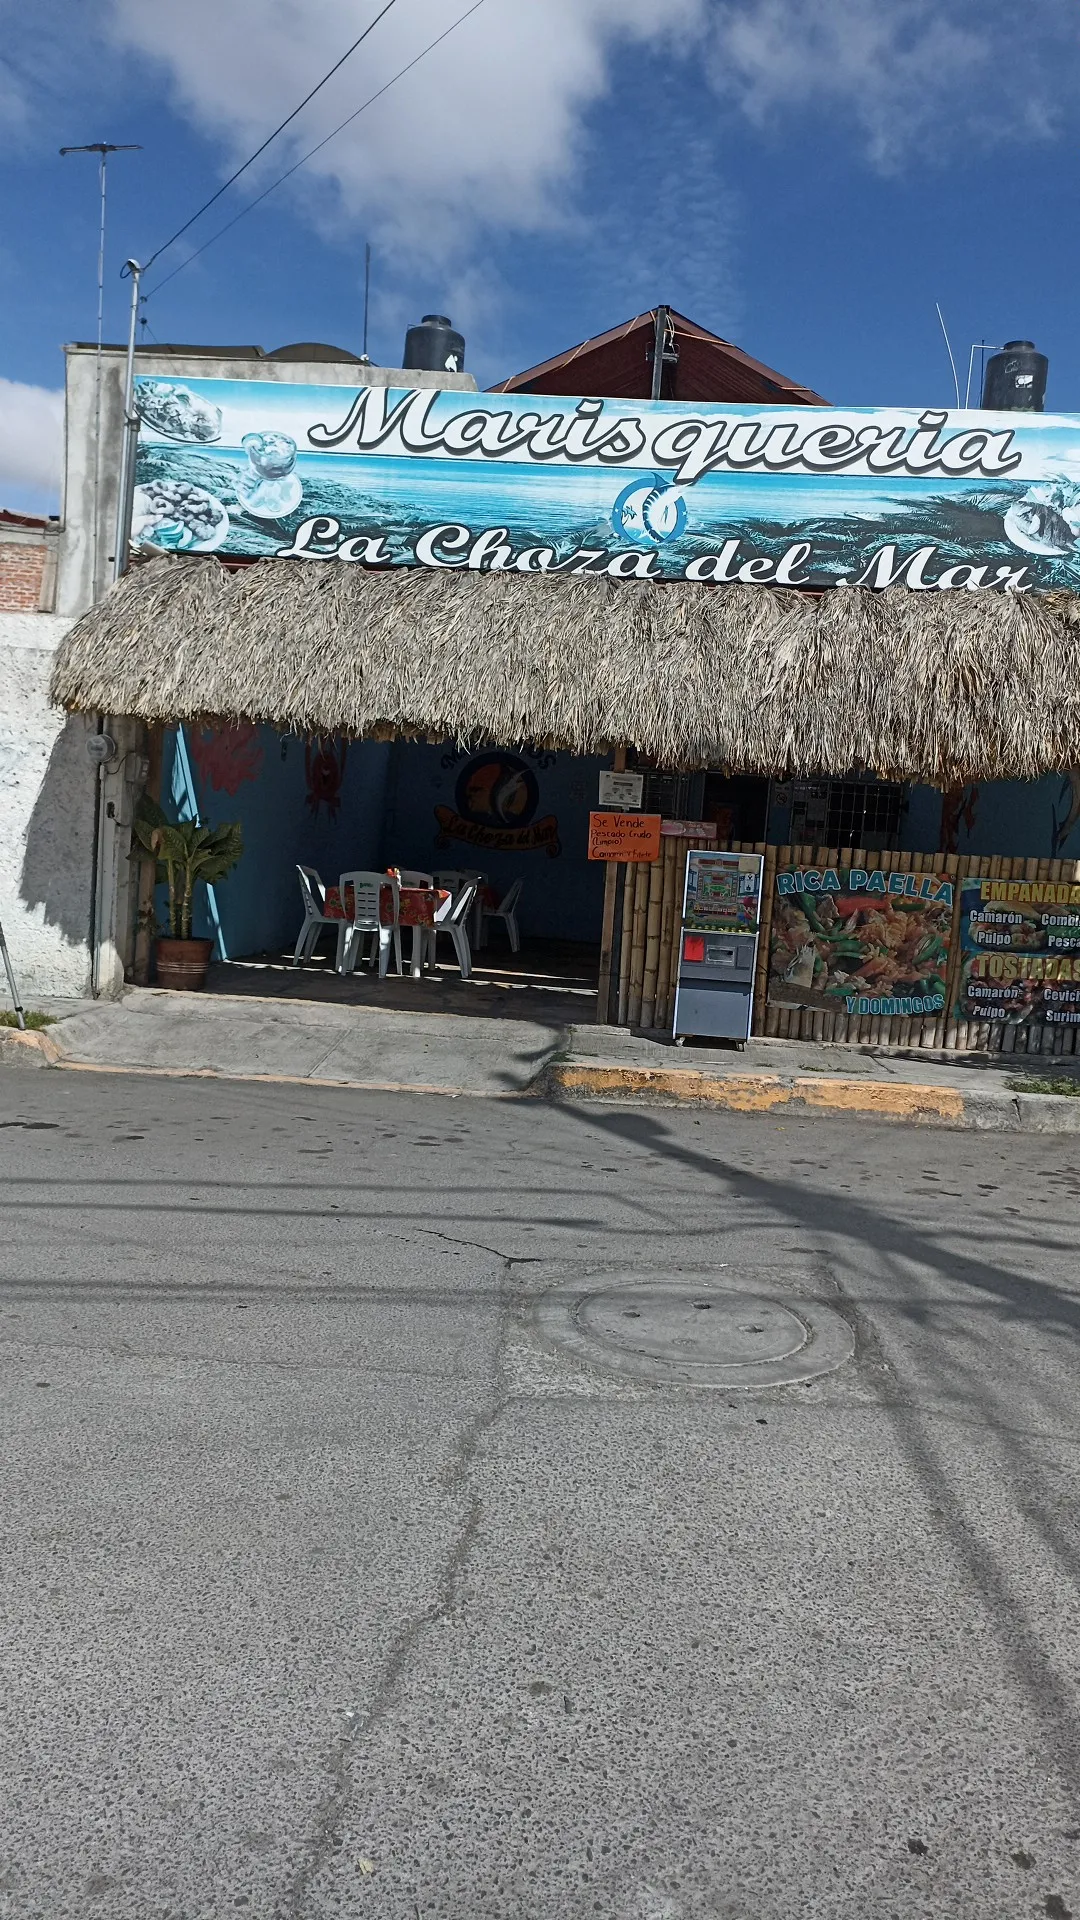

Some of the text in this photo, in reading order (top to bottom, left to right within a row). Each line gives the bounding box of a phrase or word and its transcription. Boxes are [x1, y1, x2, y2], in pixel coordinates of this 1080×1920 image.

[309, 387, 1023, 485] Marisqueria
[276, 516, 1032, 592] La Choza del Mar
[593, 813, 645, 828] Se Vende
[591, 829, 652, 838] Pescado Crudo
[777, 868, 954, 906] RICA PAELLA
[969, 910, 1023, 924] Camarón
[977, 932, 1012, 945] Pulpo
[967, 985, 1018, 998] Camarón
[846, 994, 944, 1015] Y DOMINGOS
[972, 1005, 1006, 1018] Pulpo
